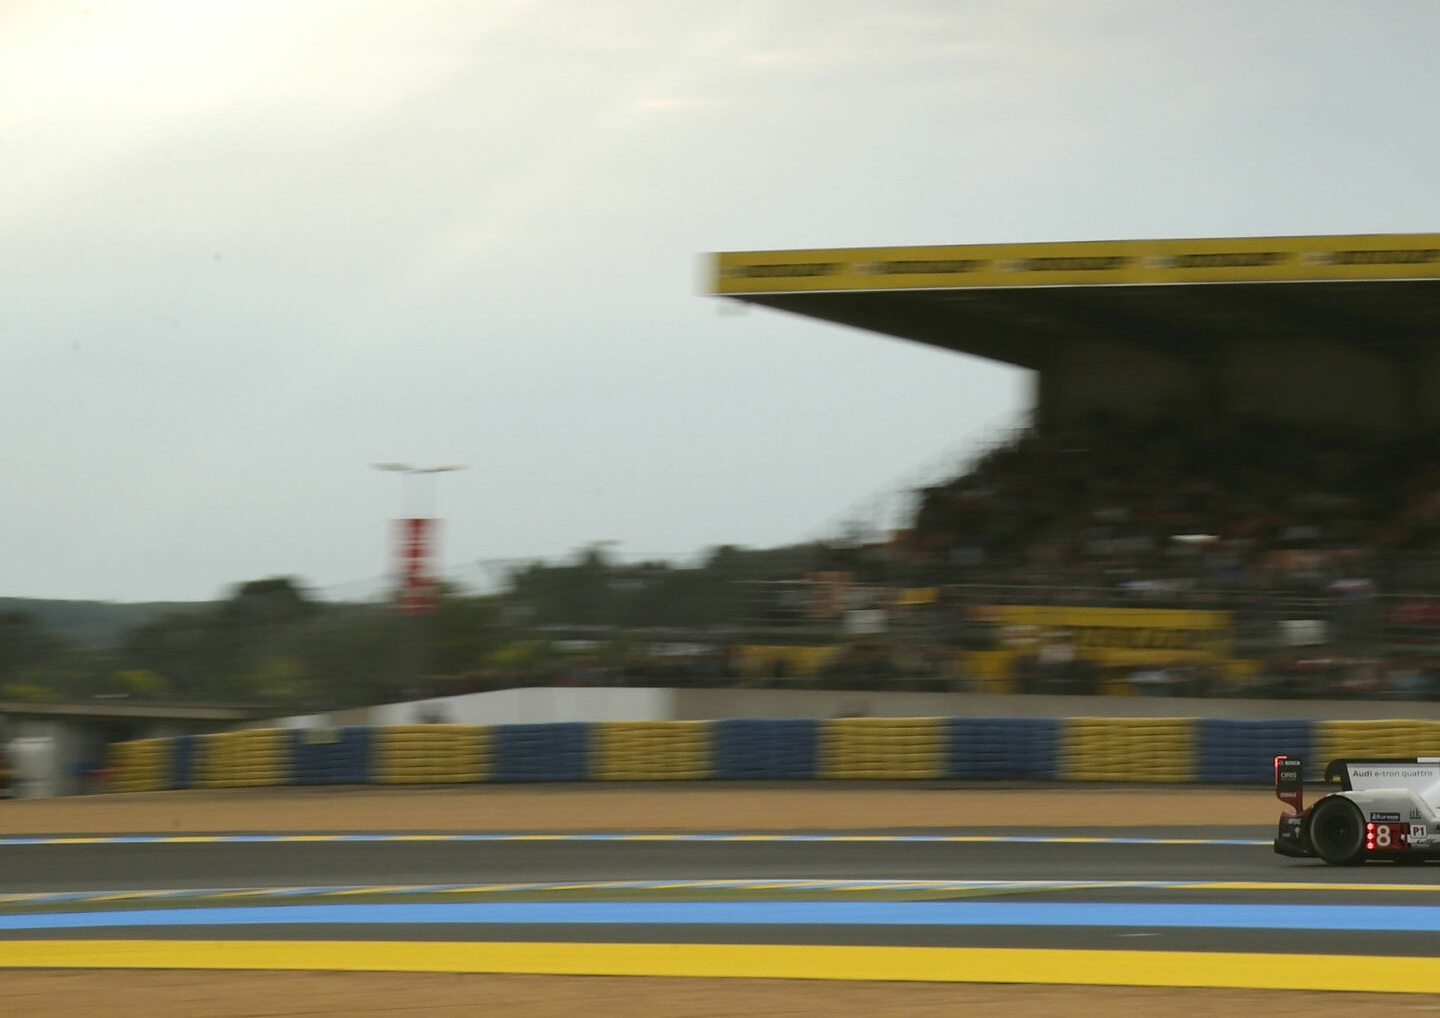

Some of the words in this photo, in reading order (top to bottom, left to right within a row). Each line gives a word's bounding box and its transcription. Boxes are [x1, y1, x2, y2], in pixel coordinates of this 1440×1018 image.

[1402, 770, 1433, 778] quattro
[1376, 825, 1391, 846] 8
[1413, 826, 1424, 836] P1
